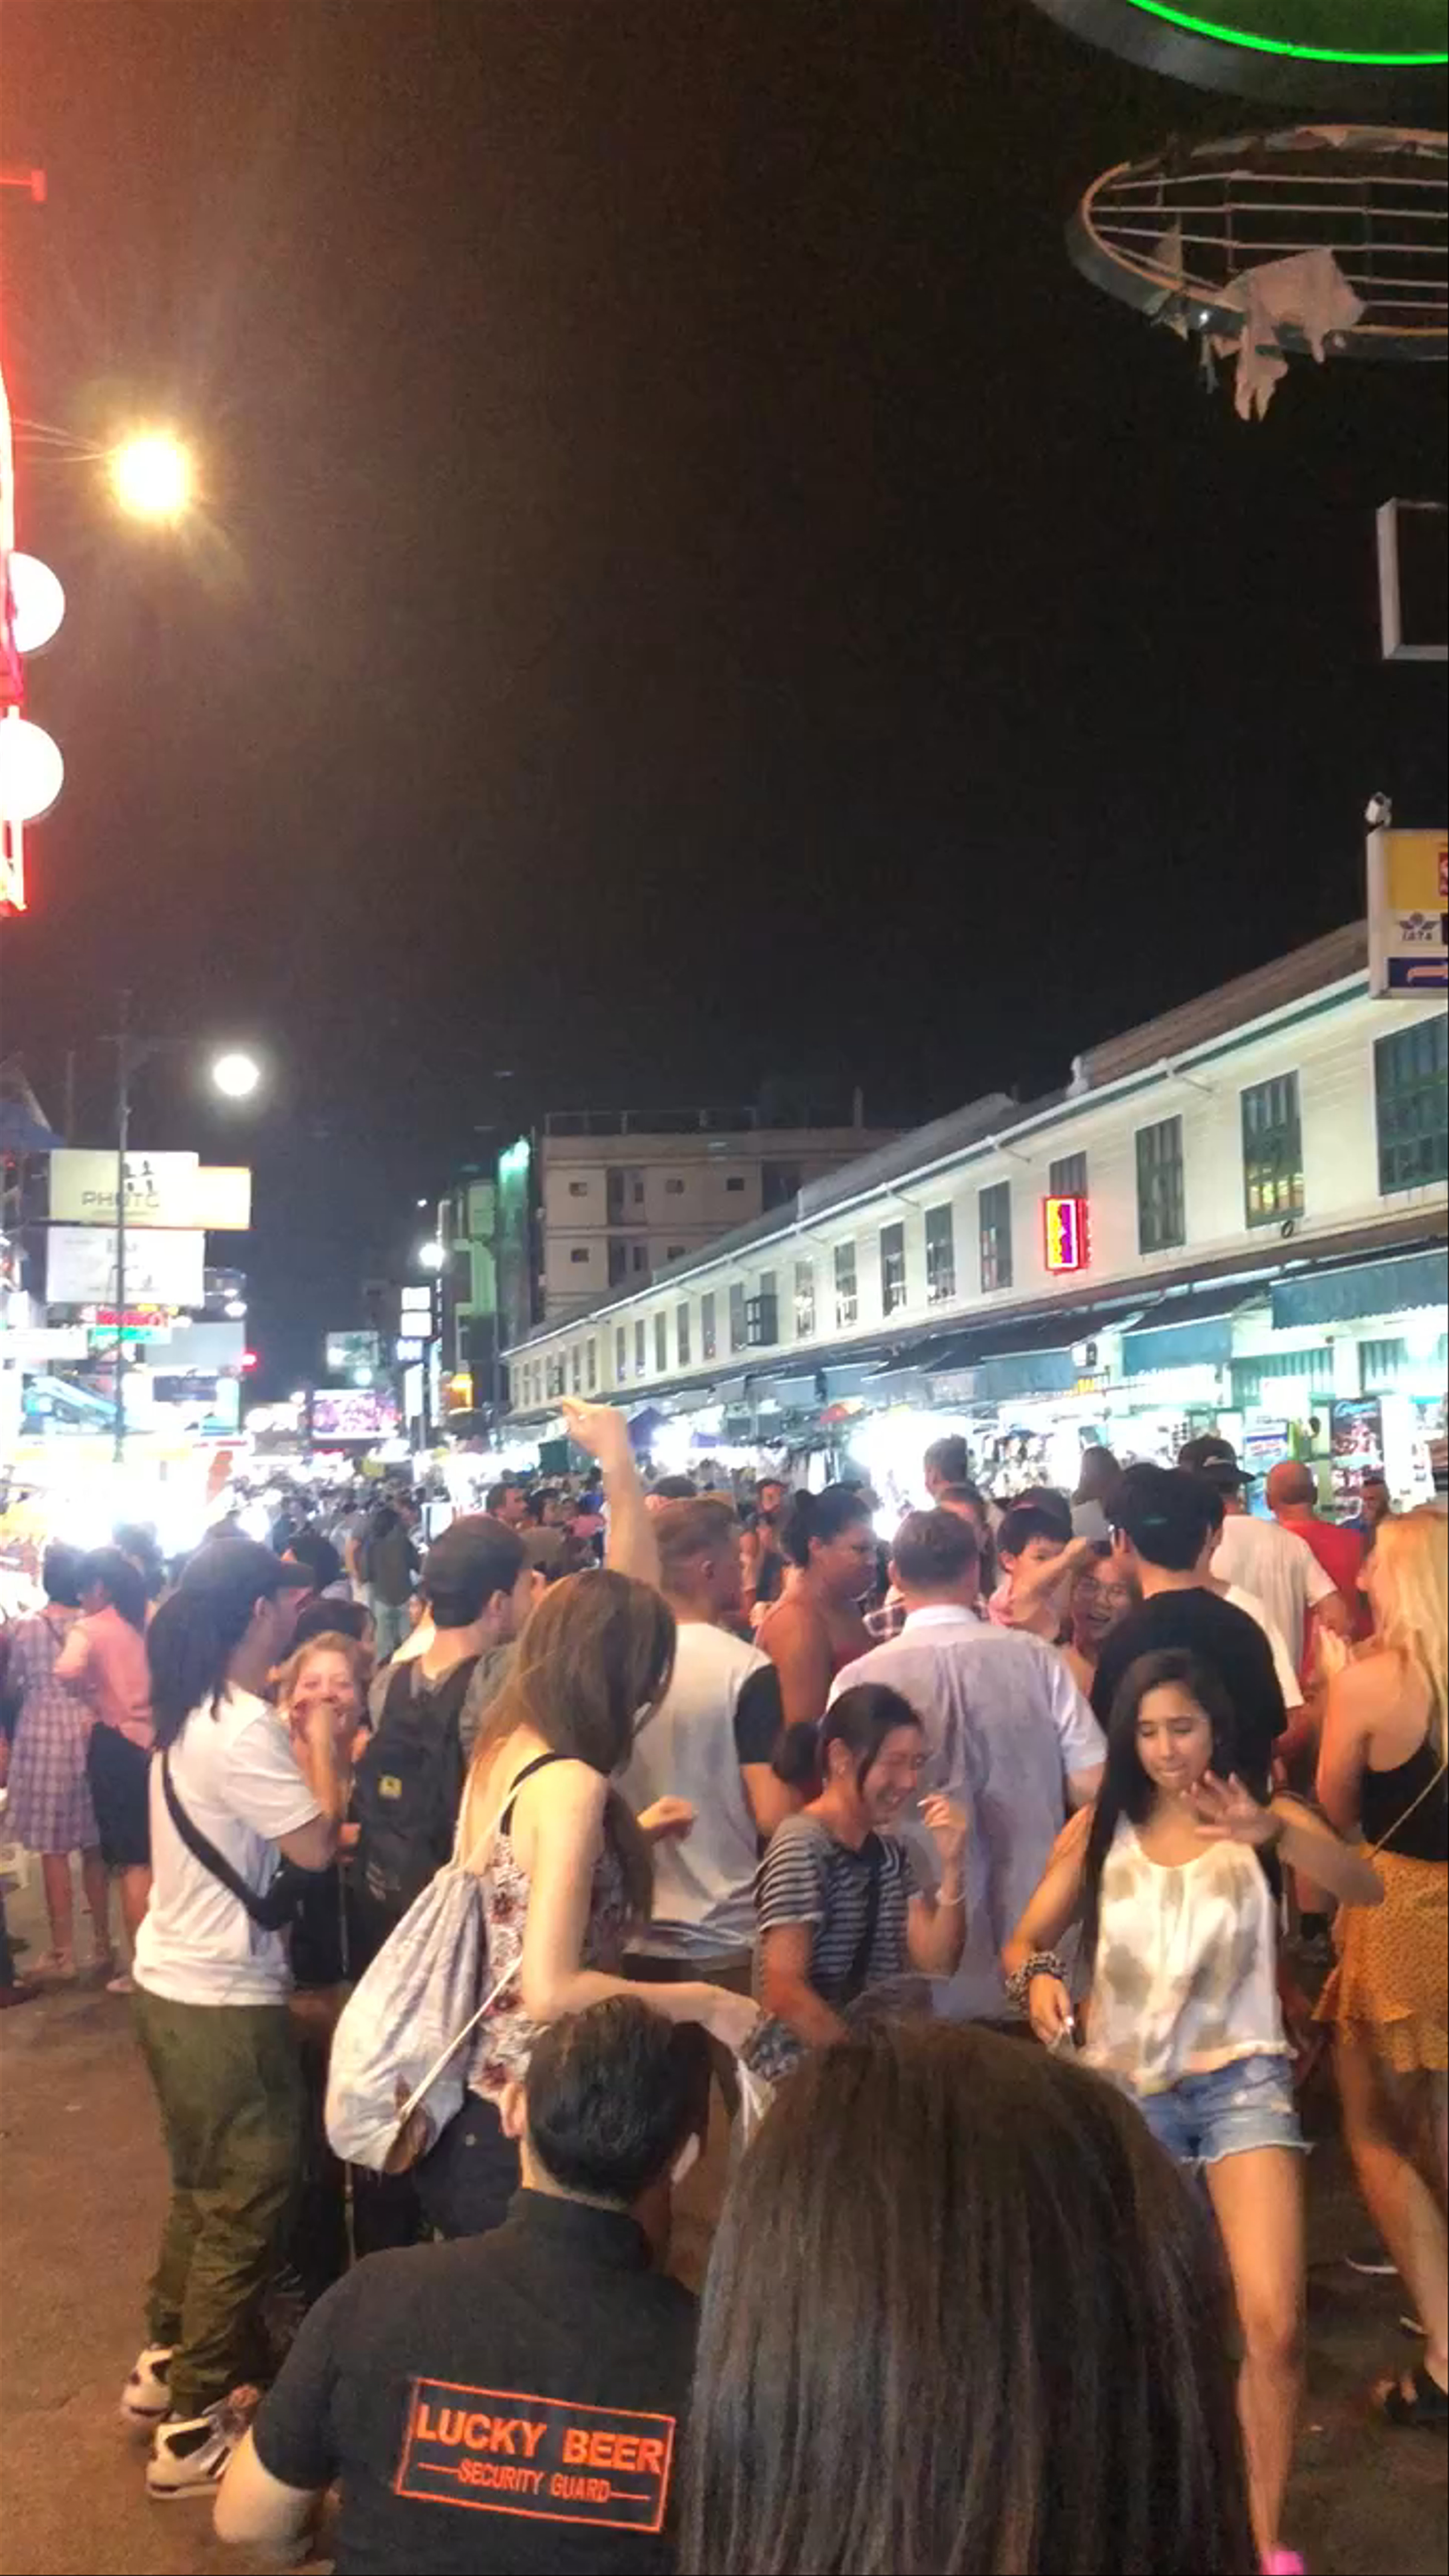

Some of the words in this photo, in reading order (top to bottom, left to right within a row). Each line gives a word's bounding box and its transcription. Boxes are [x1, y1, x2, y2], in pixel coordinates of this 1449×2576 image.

[1402, 930, 1432, 941] IATA
[417, 2404, 547, 2457] LUCKY
[563, 2429, 664, 2473] BEER
[458, 2458, 545, 2494] SECURITY
[550, 2473, 611, 2502] GUARD
